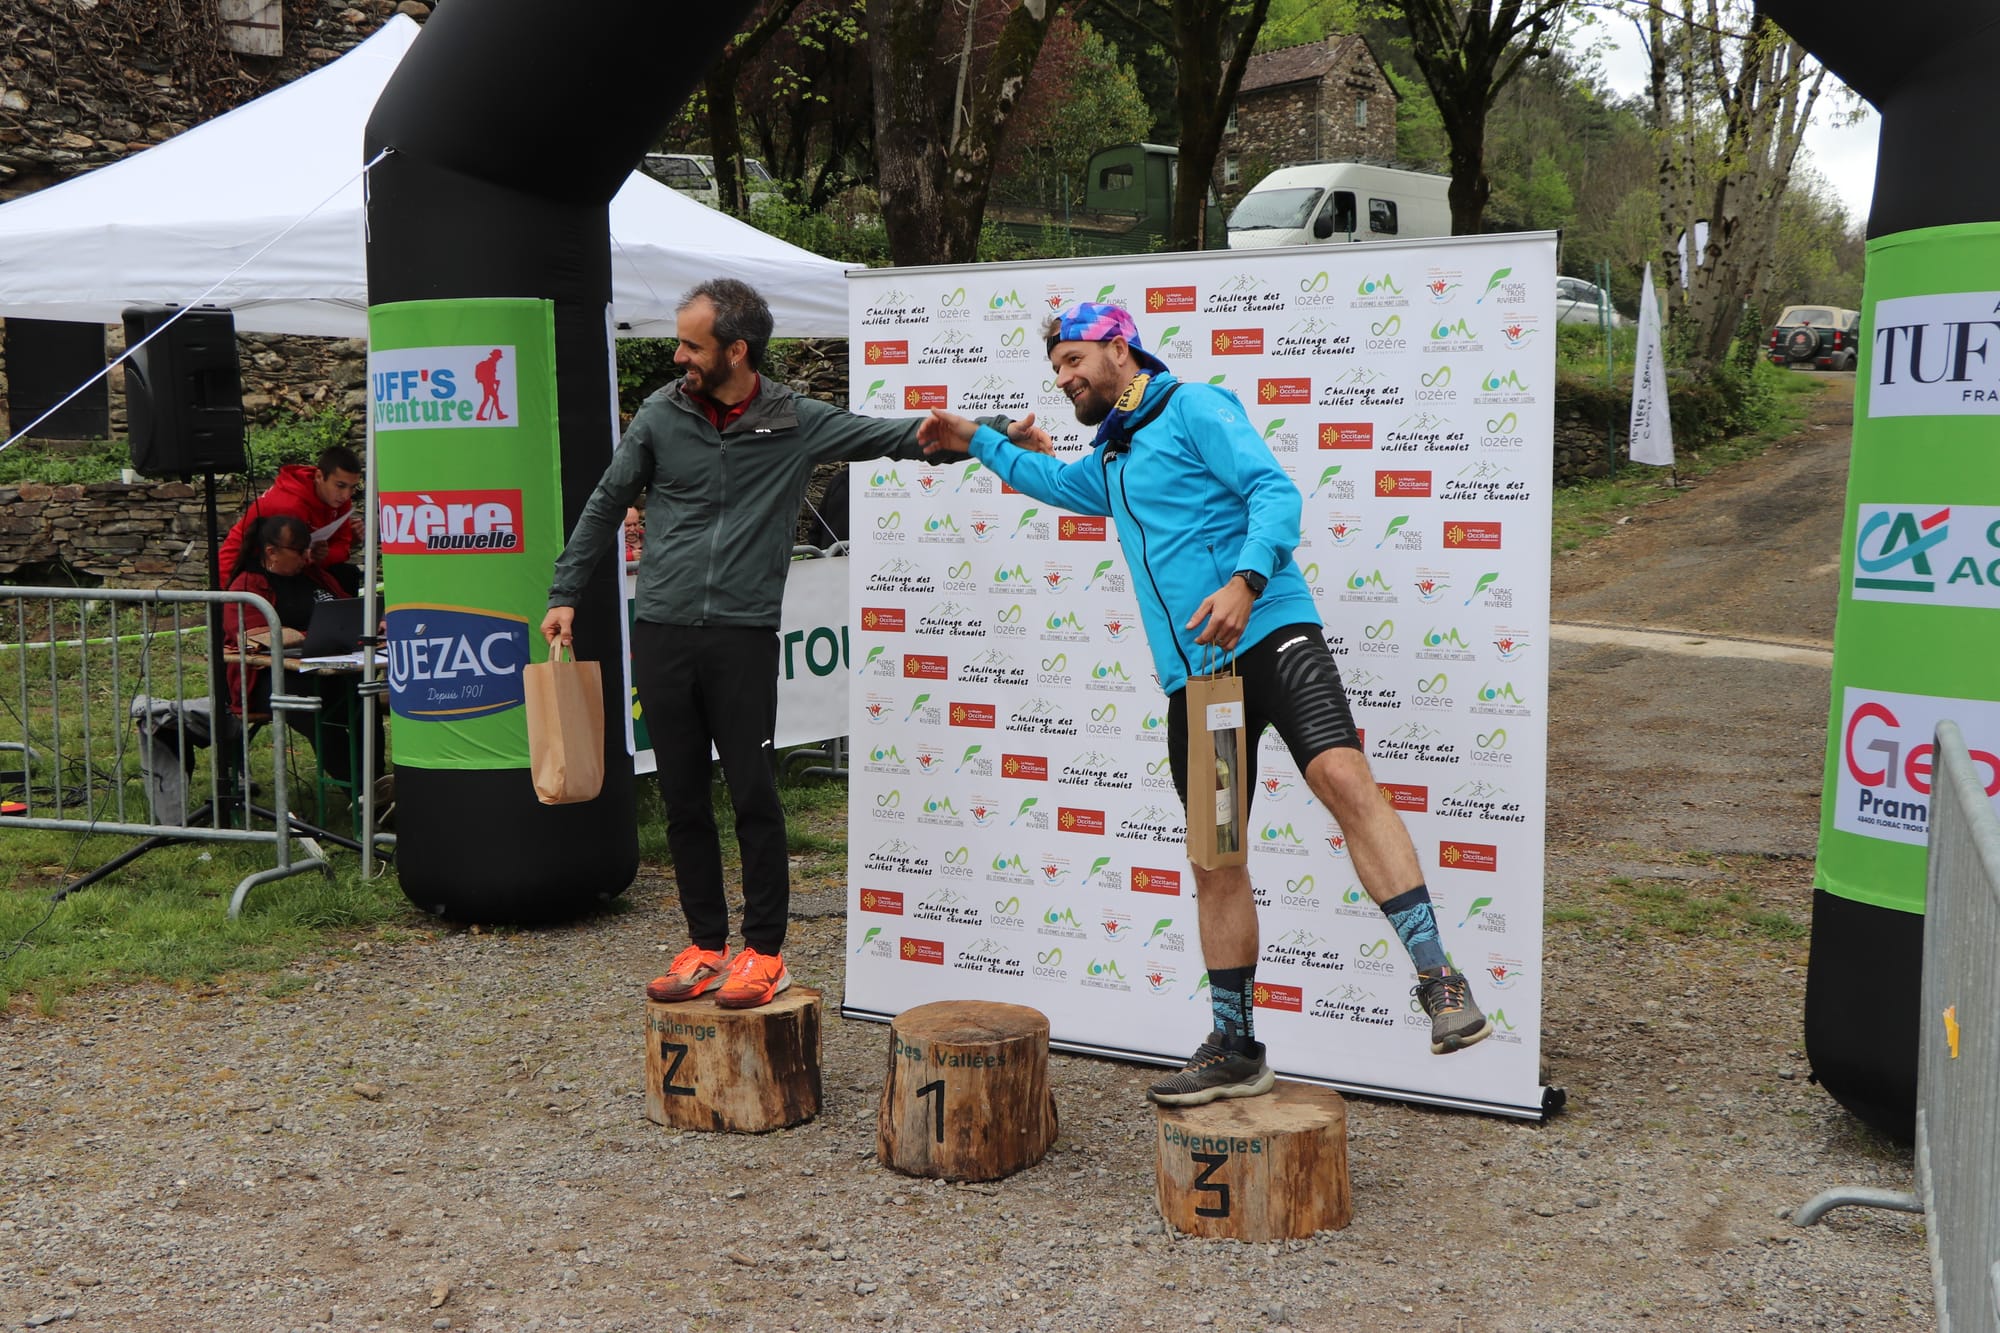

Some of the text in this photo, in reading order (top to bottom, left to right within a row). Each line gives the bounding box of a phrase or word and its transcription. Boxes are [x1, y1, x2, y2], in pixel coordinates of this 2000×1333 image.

[1208, 292, 1280, 306] Challenge des
[1294, 293, 1335, 306] lozère
[866, 306, 925, 318] Challenge des
[936, 307, 970, 319] lozère
[1203, 301, 1285, 313] vallées cévenoles
[862, 315, 929, 325] vallées cévenoles
[1276, 335, 1350, 348] Challenge des
[1365, 337, 1407, 350] lozère
[1271, 345, 1356, 356] vallées cévenoles
[373, 369, 456, 401] UFF'S
[962, 392, 1024, 403] Challenge des
[1324, 386, 1399, 398] Challenge des
[1415, 388, 1458, 401] lozère
[958, 400, 1029, 410] vallées cévenoles
[1318, 395, 1405, 406] vallées cévenoles
[1480, 435, 1523, 447] lozère
[1445, 480, 1524, 492] Challenge des
[1440, 490, 1530, 501] vallées cévenoles
[379, 495, 512, 543] ozère
[427, 533, 516, 550] nouvelle
[872, 530, 905, 541] lozère
[870, 573, 931, 585] Challenge des
[943, 580, 977, 591] lozère
[865, 582, 935, 593] vallées cévenoles
[919, 616, 982, 629] Challenge des
[915, 625, 986, 637] vallées cévenoles
[1359, 640, 1400, 653] lozère
[1036, 672, 1072, 685] lozère
[427, 684, 483, 706] Depuis 1901
[1411, 694, 1453, 708] lozère
[1085, 722, 1122, 735] lozère
[1377, 739, 1454, 754] Challenge des
[1372, 748, 1460, 764] vallées cévenoles
[1470, 749, 1513, 763] lozère
[1020, 764, 1046, 772] Occitanie
[1061, 766, 1128, 780] Challenge des
[1057, 775, 1133, 790] vallées cévenoles
[1394, 794, 1426, 802] Occitanie
[1441, 796, 1520, 812] Challenge des
[872, 807, 905, 820] lozère
[1435, 806, 1526, 823] vallées cévenoles
[1876, 818, 1901, 829] FLORAC
[1903, 823, 1924, 832] TROIS
[869, 852, 928, 867] Challenge des
[1462, 853, 1494, 861] Occitanie
[864, 860, 932, 876] vallées cévenoles
[940, 864, 973, 877] lozère
[1150, 878, 1178, 886] Occitanie
[877, 898, 901, 906] Occitanie
[1280, 893, 1320, 908] lozère
[990, 914, 1024, 928] lozère
[917, 948, 942, 956] Occitanie
[1266, 943, 1340, 960] Challenge des
[958, 951, 1020, 967] Challenge des
[1261, 952, 1345, 971] vallées cévenoles
[1353, 957, 1394, 973] lozère
[954, 960, 1025, 977] vallées cévenoles
[1032, 964, 1067, 979] lozère
[1271, 993, 1300, 1002] Occitanie
[1314, 998, 1389, 1016] Challenge des
[1309, 1007, 1395, 1027] vallées cévenoles
[896, 1037, 1006, 1069] Des Vallées
[916, 1080, 946, 1143] 1
[1163, 1123, 1262, 1154] Cévenoles
[1191, 1152, 1230, 1218] 3
